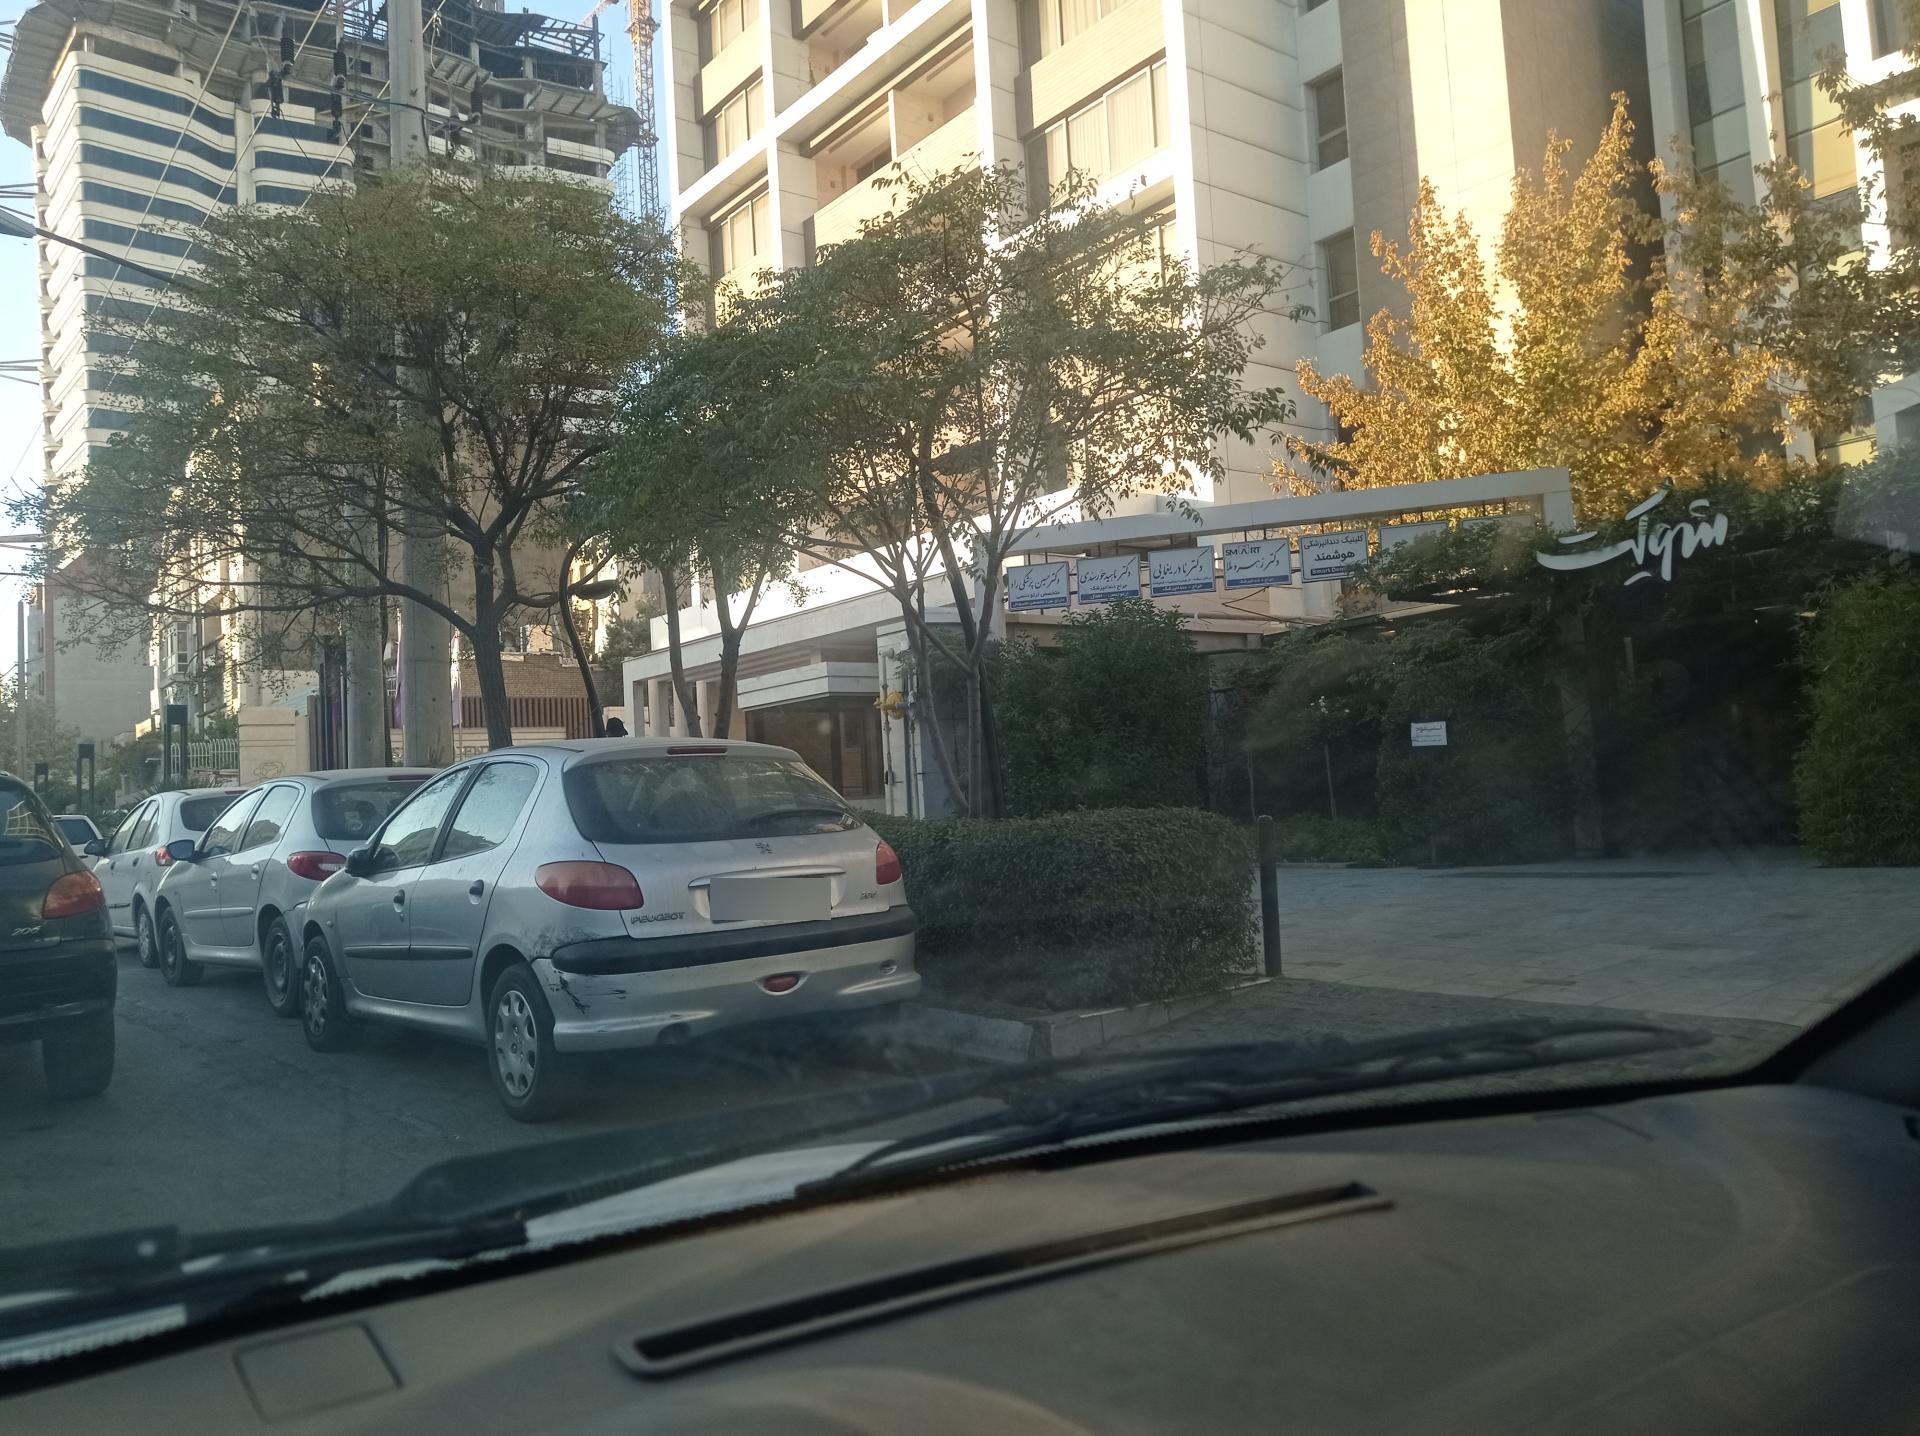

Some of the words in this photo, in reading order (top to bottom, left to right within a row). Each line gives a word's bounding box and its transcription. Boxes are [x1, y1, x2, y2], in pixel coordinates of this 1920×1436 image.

[1304, 538, 1340, 550] دندانپزشکی
[1341, 534, 1363, 545] کلینیک
[1225, 546, 1261, 556] SMART
[1264, 542, 1287, 571] دکتر
[1314, 550, 1356, 562] هوشمند
[1116, 556, 1137, 581] دکتر
[1185, 548, 1209, 577] دکتر
[1046, 564, 1065, 588] دکتر
[630, 911, 686, 925] PEUGEOT
[10, 925, 41, 936] 206
